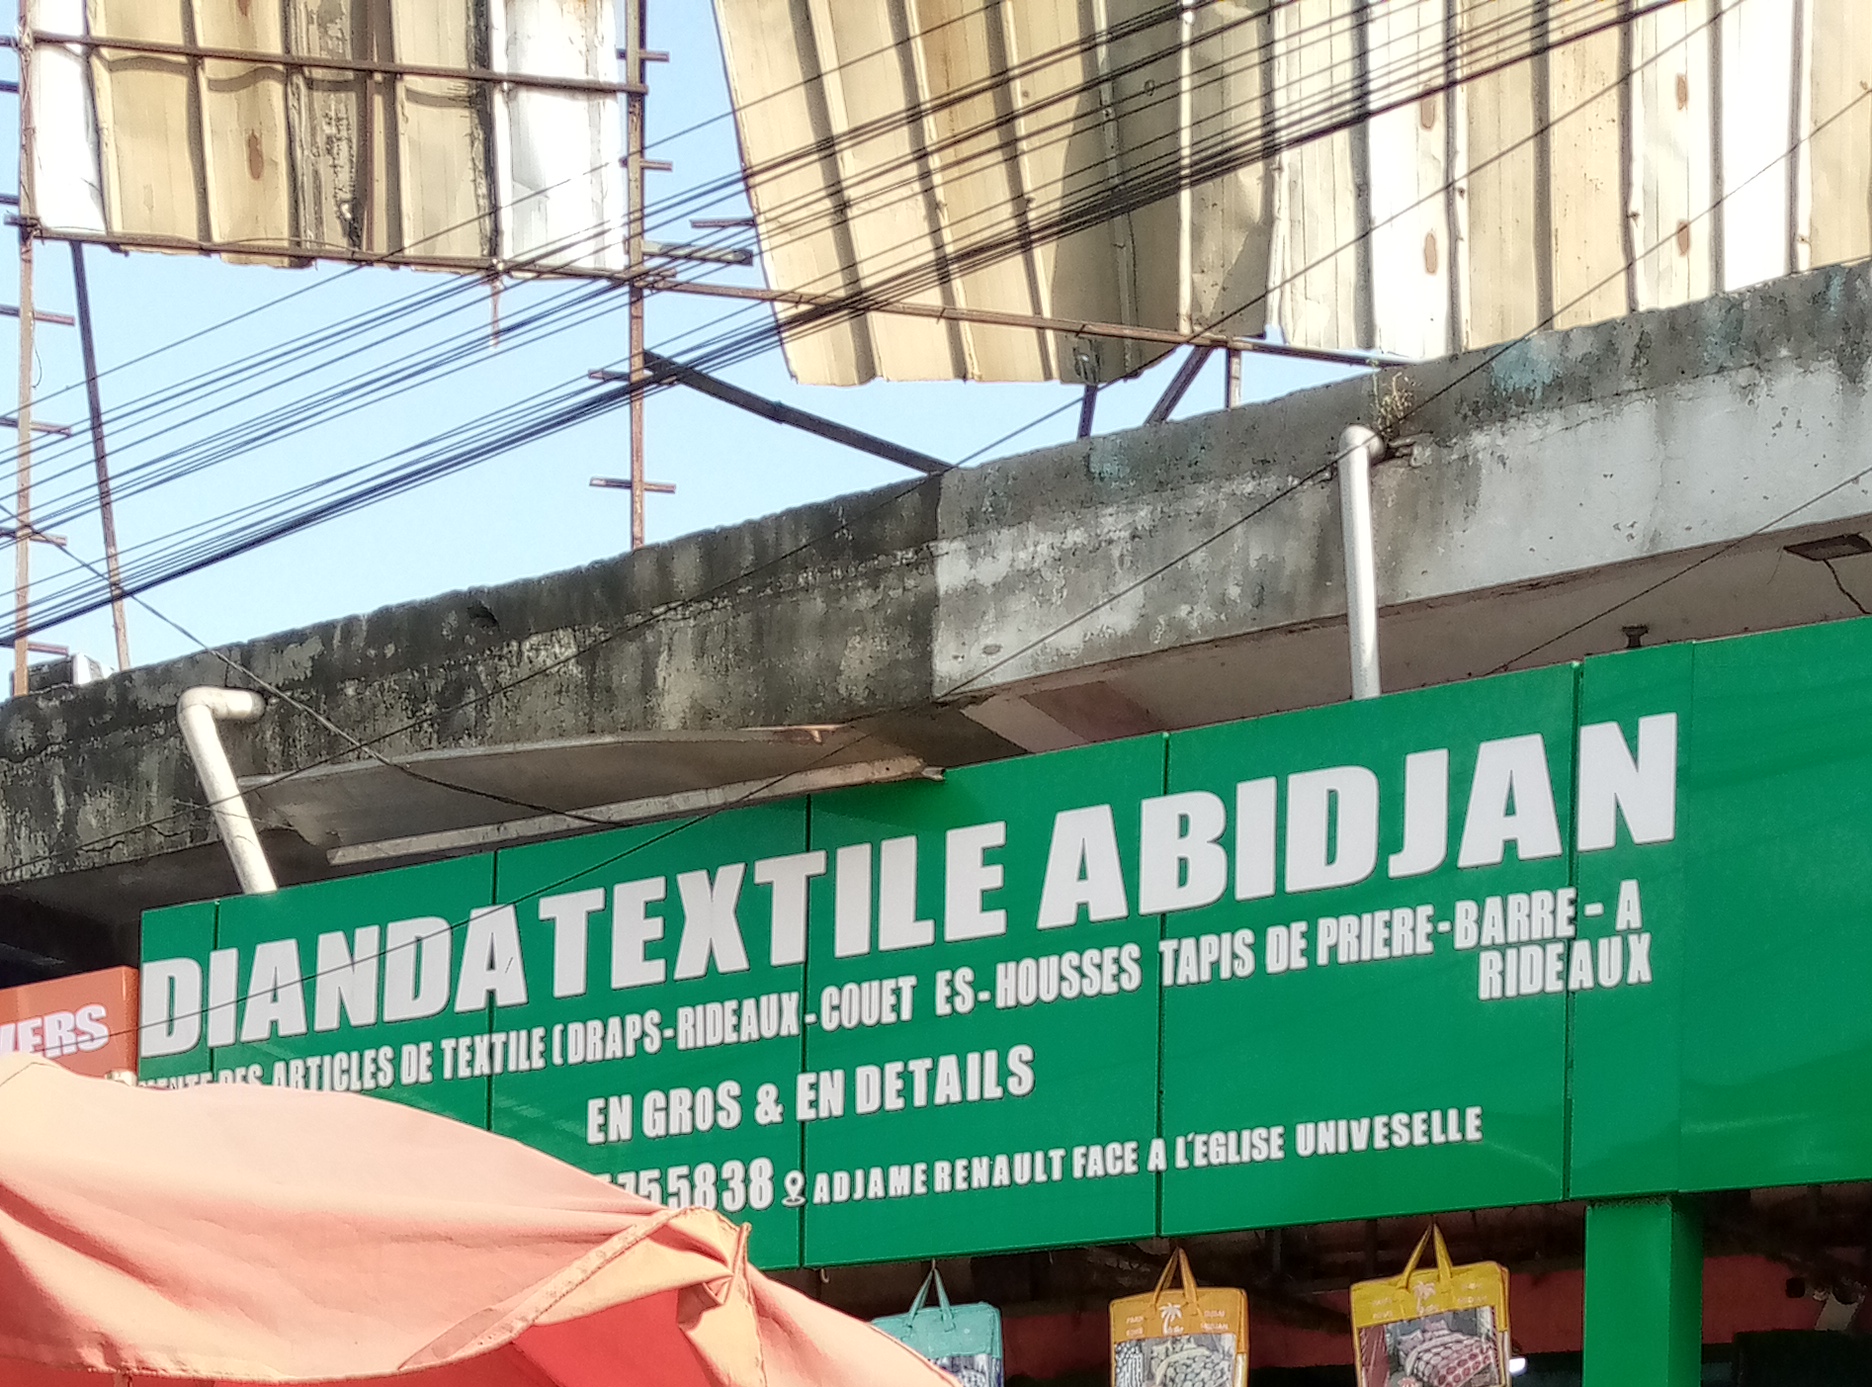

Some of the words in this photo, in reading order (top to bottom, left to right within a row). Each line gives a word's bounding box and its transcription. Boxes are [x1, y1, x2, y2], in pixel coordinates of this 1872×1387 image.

[141, 903, 528, 1059] DIANDA
[538, 820, 1007, 999] TEXTILE
[1036, 711, 1679, 931] ABIDJAN
[272, 1045, 394, 1091] ARTICLES
[402, 1041, 432, 1085] DE
[441, 1026, 547, 1082] TEXTILE
[1159, 928, 1255, 987] TAPIS
[1265, 921, 1308, 974] DE
[1615, 879, 1643, 931] A
[1478, 932, 1652, 1000] RIDEAUX
[586, 1094, 633, 1145] EN
[642, 1080, 742, 1139] GROS
[754, 1082, 785, 1126] &
[796, 1069, 845, 1121] EN
[854, 1044, 1035, 1115] DETAILS
[813, 1163, 928, 1205] ADJAME
[933, 1148, 1066, 1193] RENAULT
[1071, 1141, 1139, 1180] FACE
[1147, 1137, 1168, 1172] A
[1295, 1105, 1483, 1158] UNIVESELLE
